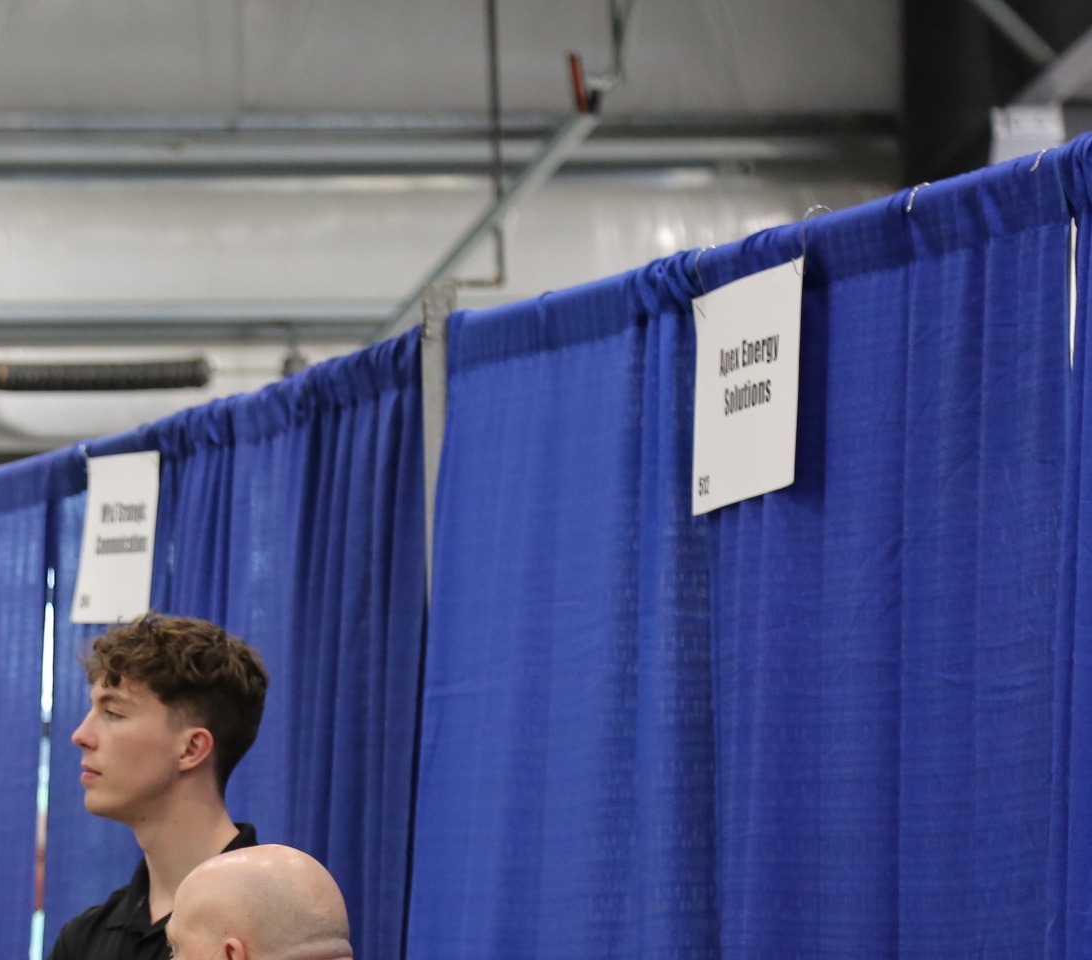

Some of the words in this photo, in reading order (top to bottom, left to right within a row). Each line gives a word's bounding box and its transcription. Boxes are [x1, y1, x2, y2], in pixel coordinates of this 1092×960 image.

[720, 348, 740, 377] Apex
[742, 334, 779, 368] Energy
[724, 379, 771, 416] Solutions
[698, 475, 709, 497] 512
